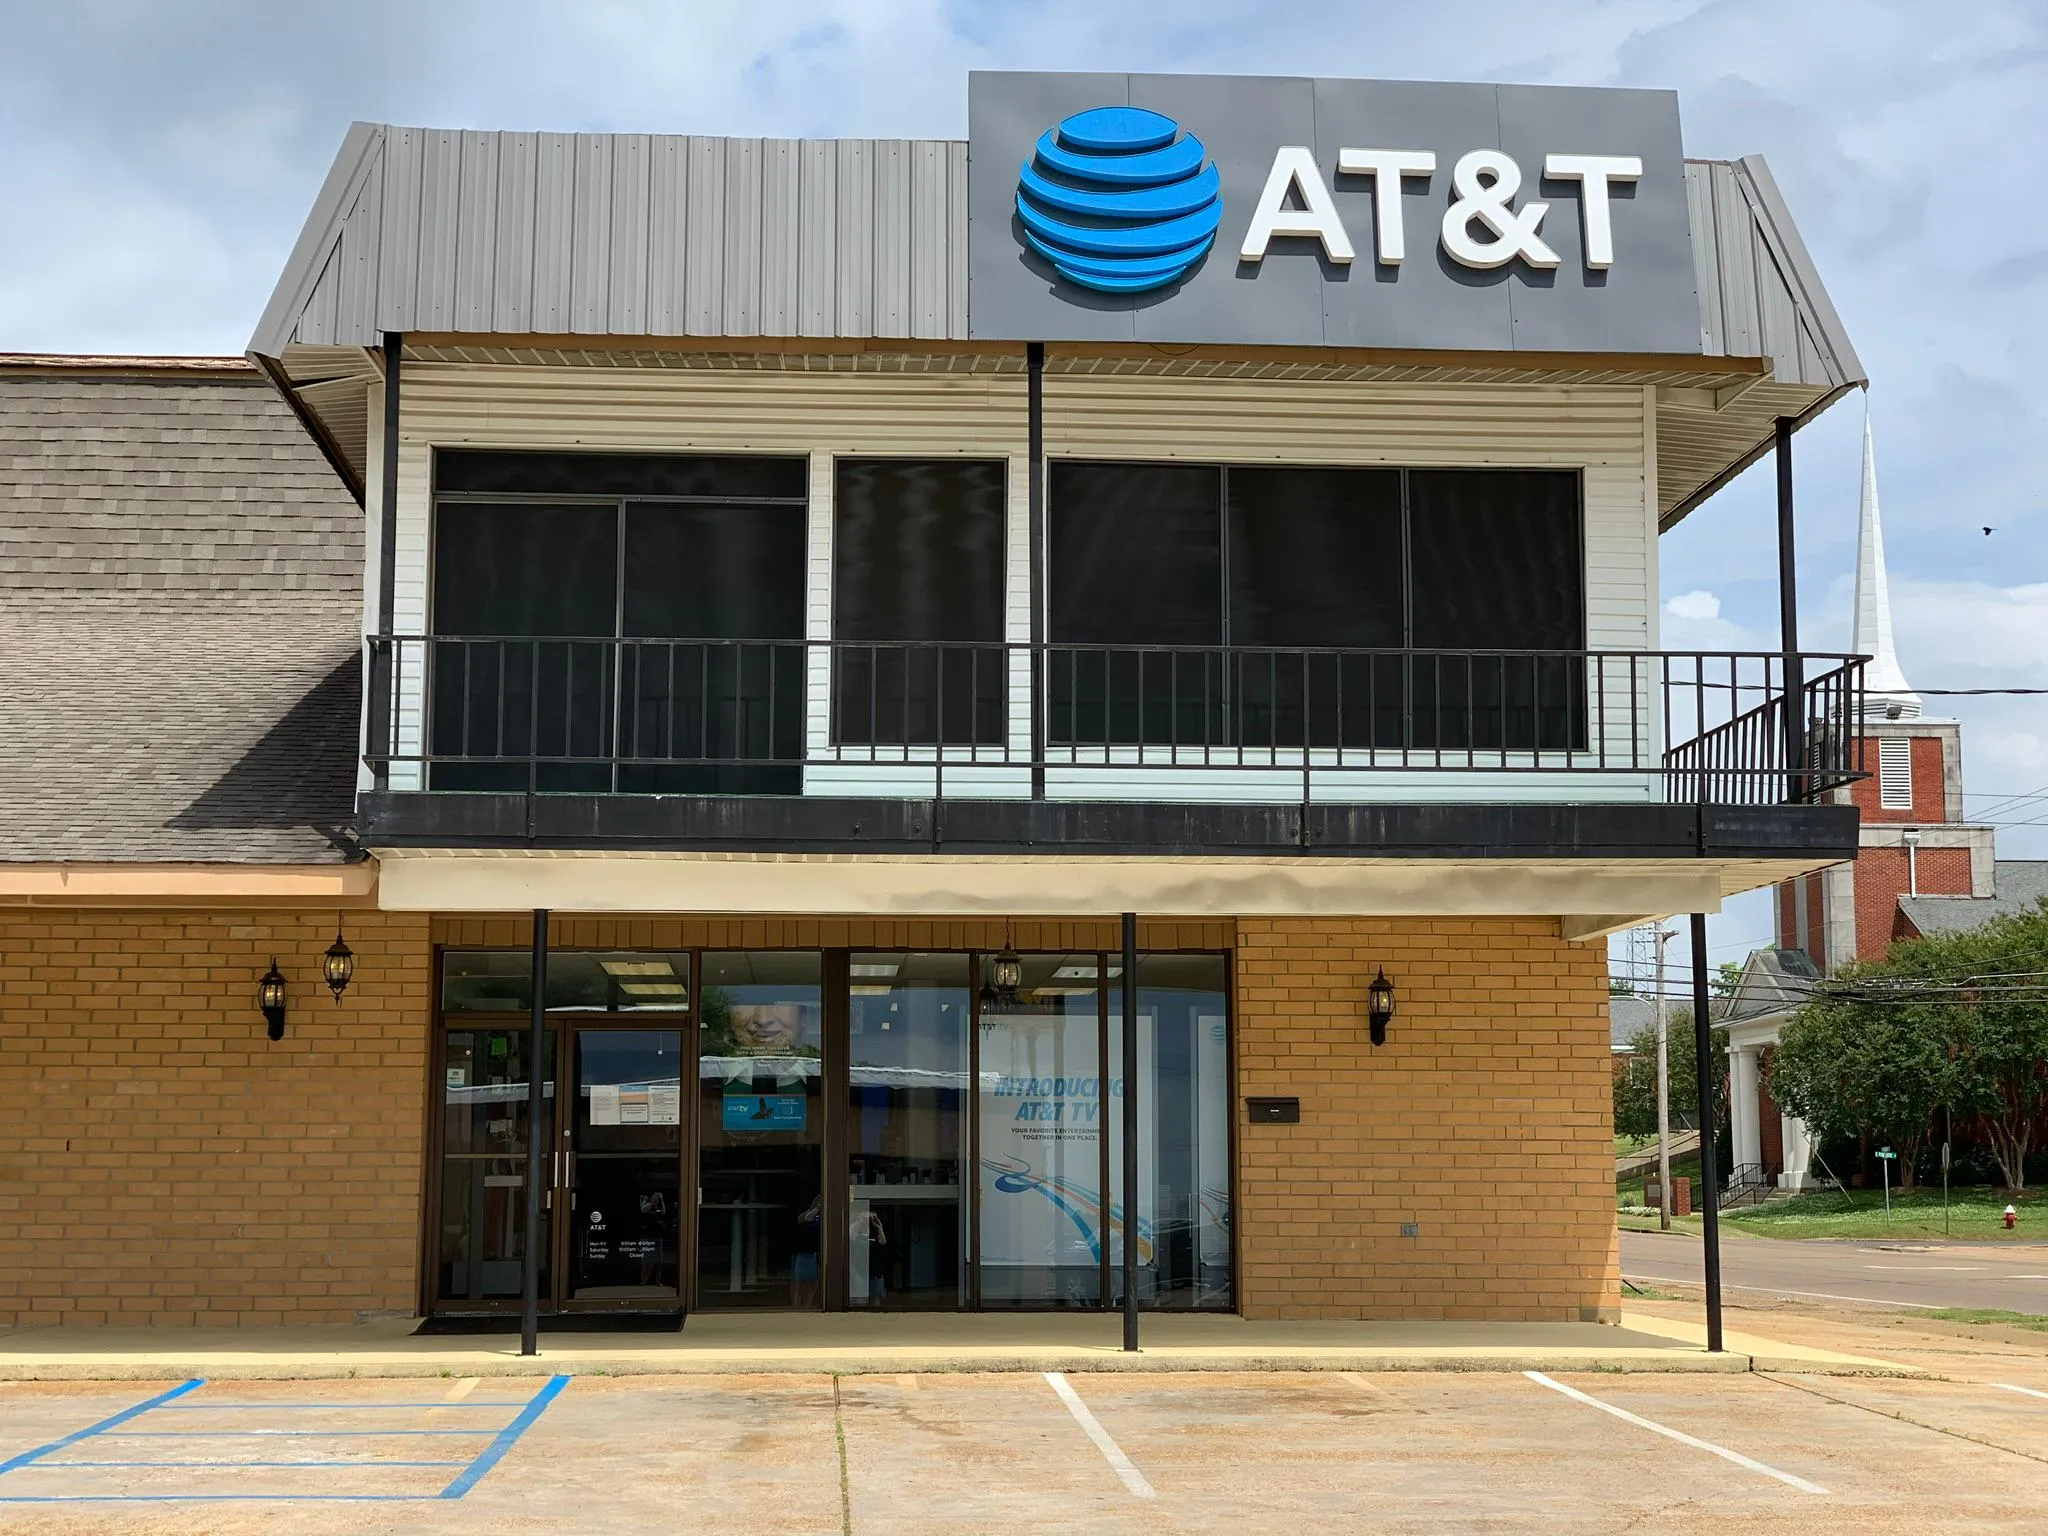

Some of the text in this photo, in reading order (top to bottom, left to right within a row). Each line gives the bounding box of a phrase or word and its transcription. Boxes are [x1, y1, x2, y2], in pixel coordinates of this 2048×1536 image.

[1239, 145, 1643, 271] AT&T
[994, 1078, 1123, 1097] INTRODUCIG
[1014, 1102, 1100, 1122] AT&T TV
